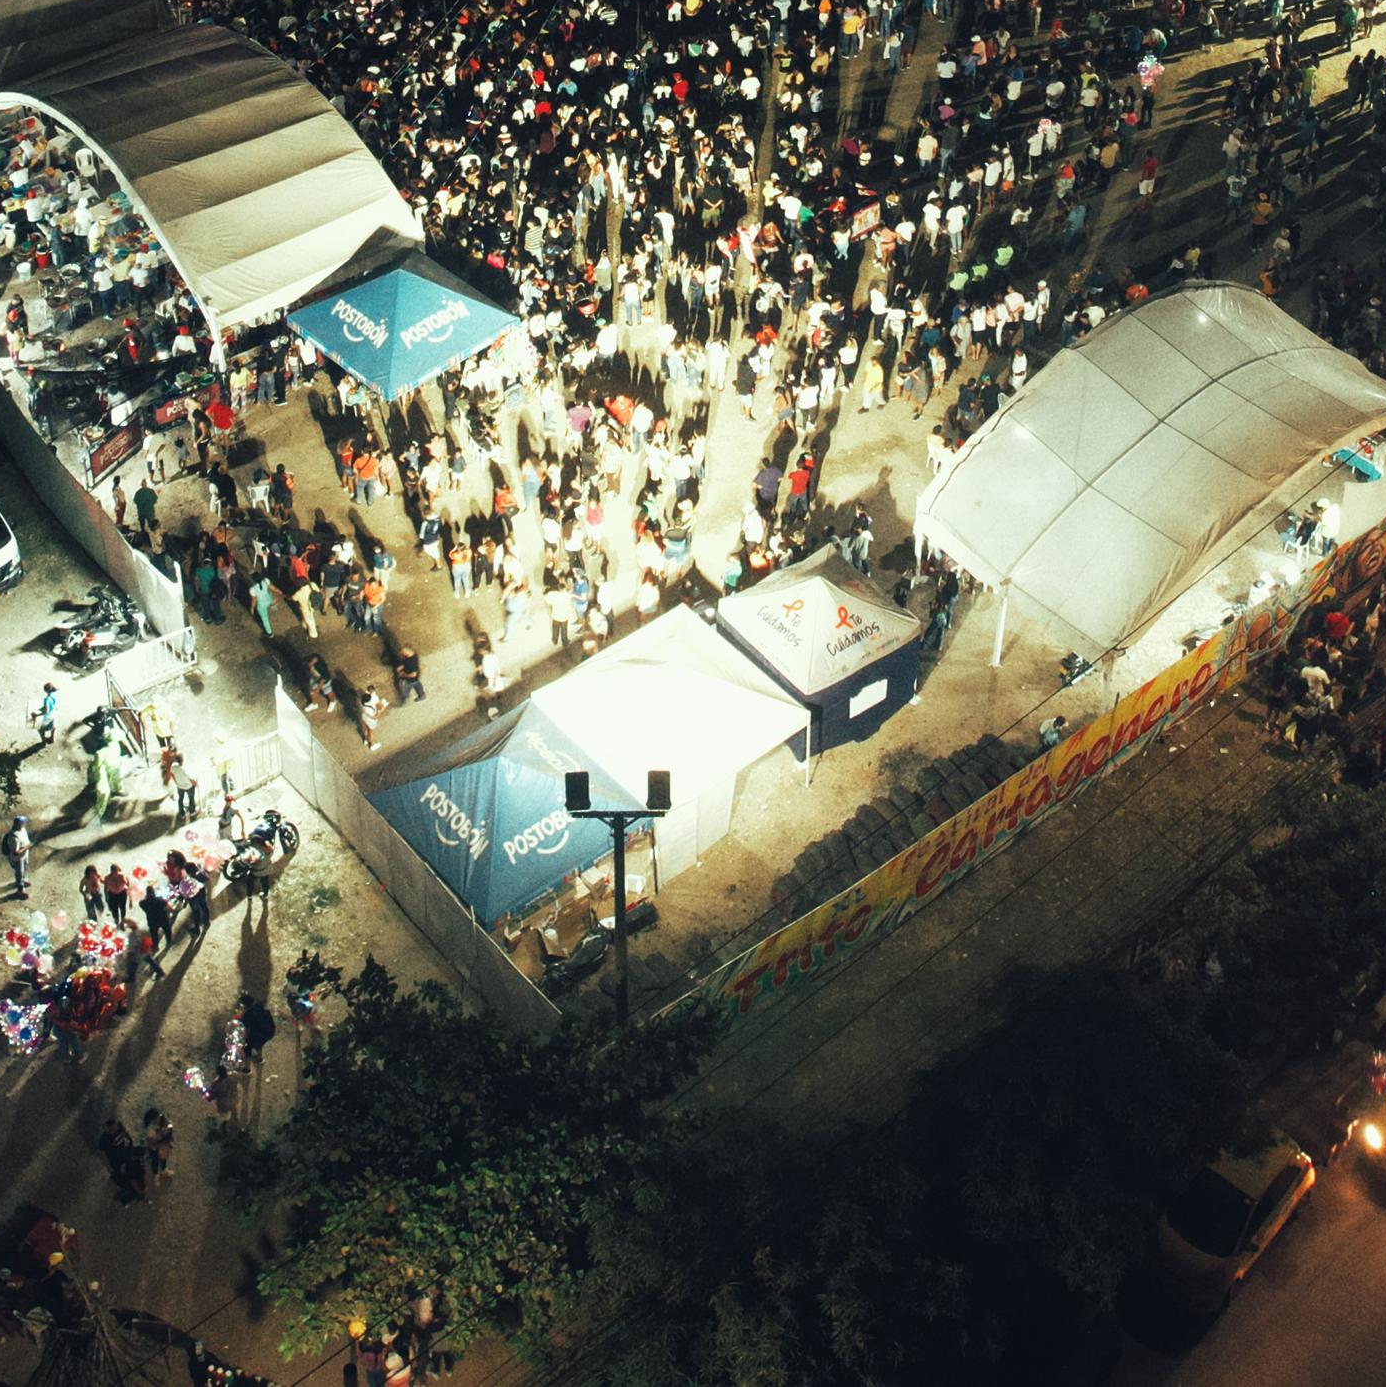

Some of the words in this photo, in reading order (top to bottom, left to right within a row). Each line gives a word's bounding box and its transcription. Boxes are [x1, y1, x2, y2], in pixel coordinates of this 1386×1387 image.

[757, 605, 803, 648] Cuidamos
[826, 621, 881, 657] Cuidamos
[850, 613, 863, 627] Te
[734, 904, 871, 1013] Frito
[915, 663, 1212, 898] Cartagenero
